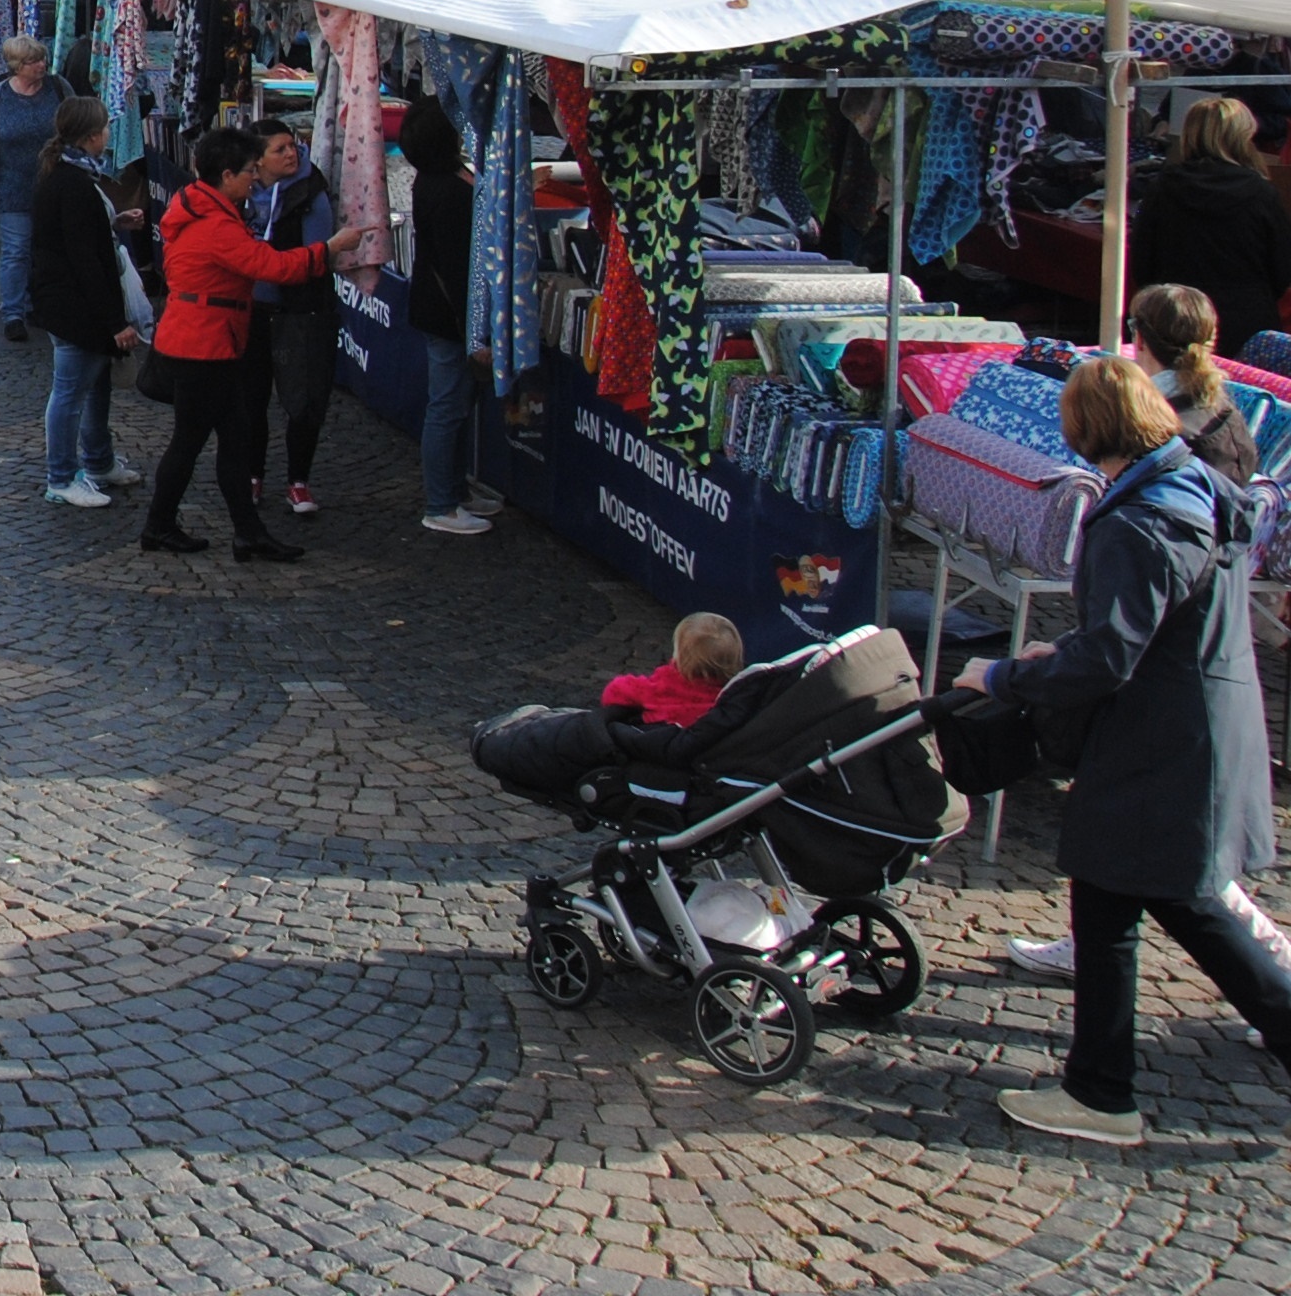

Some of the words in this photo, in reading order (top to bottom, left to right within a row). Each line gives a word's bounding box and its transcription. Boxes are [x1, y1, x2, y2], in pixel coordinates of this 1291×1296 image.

[574, 406, 600, 443] JAN
[677, 467, 731, 523] AARTS
[675, 924, 696, 961] SKY
